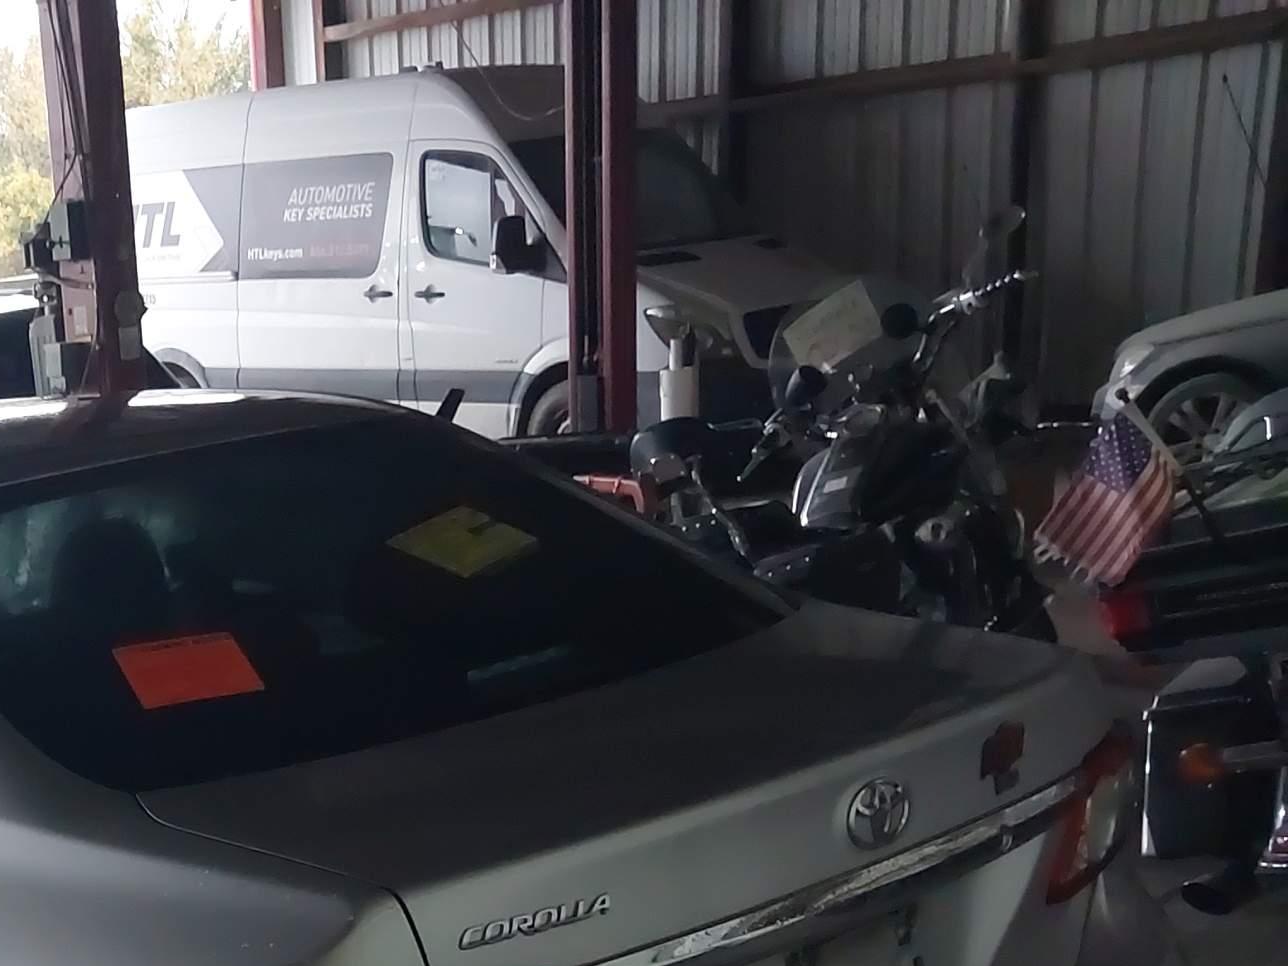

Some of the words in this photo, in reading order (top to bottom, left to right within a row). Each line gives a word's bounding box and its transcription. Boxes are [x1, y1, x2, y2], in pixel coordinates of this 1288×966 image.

[288, 182, 375, 205] AUTOMOTIVE
[283, 207, 304, 222] KEY
[306, 203, 373, 221] SPECIALISTS
[133, 201, 181, 248] TL
[247, 247, 303, 261] HTLkeys.com
[458, 892, 611, 950] COROLLA
